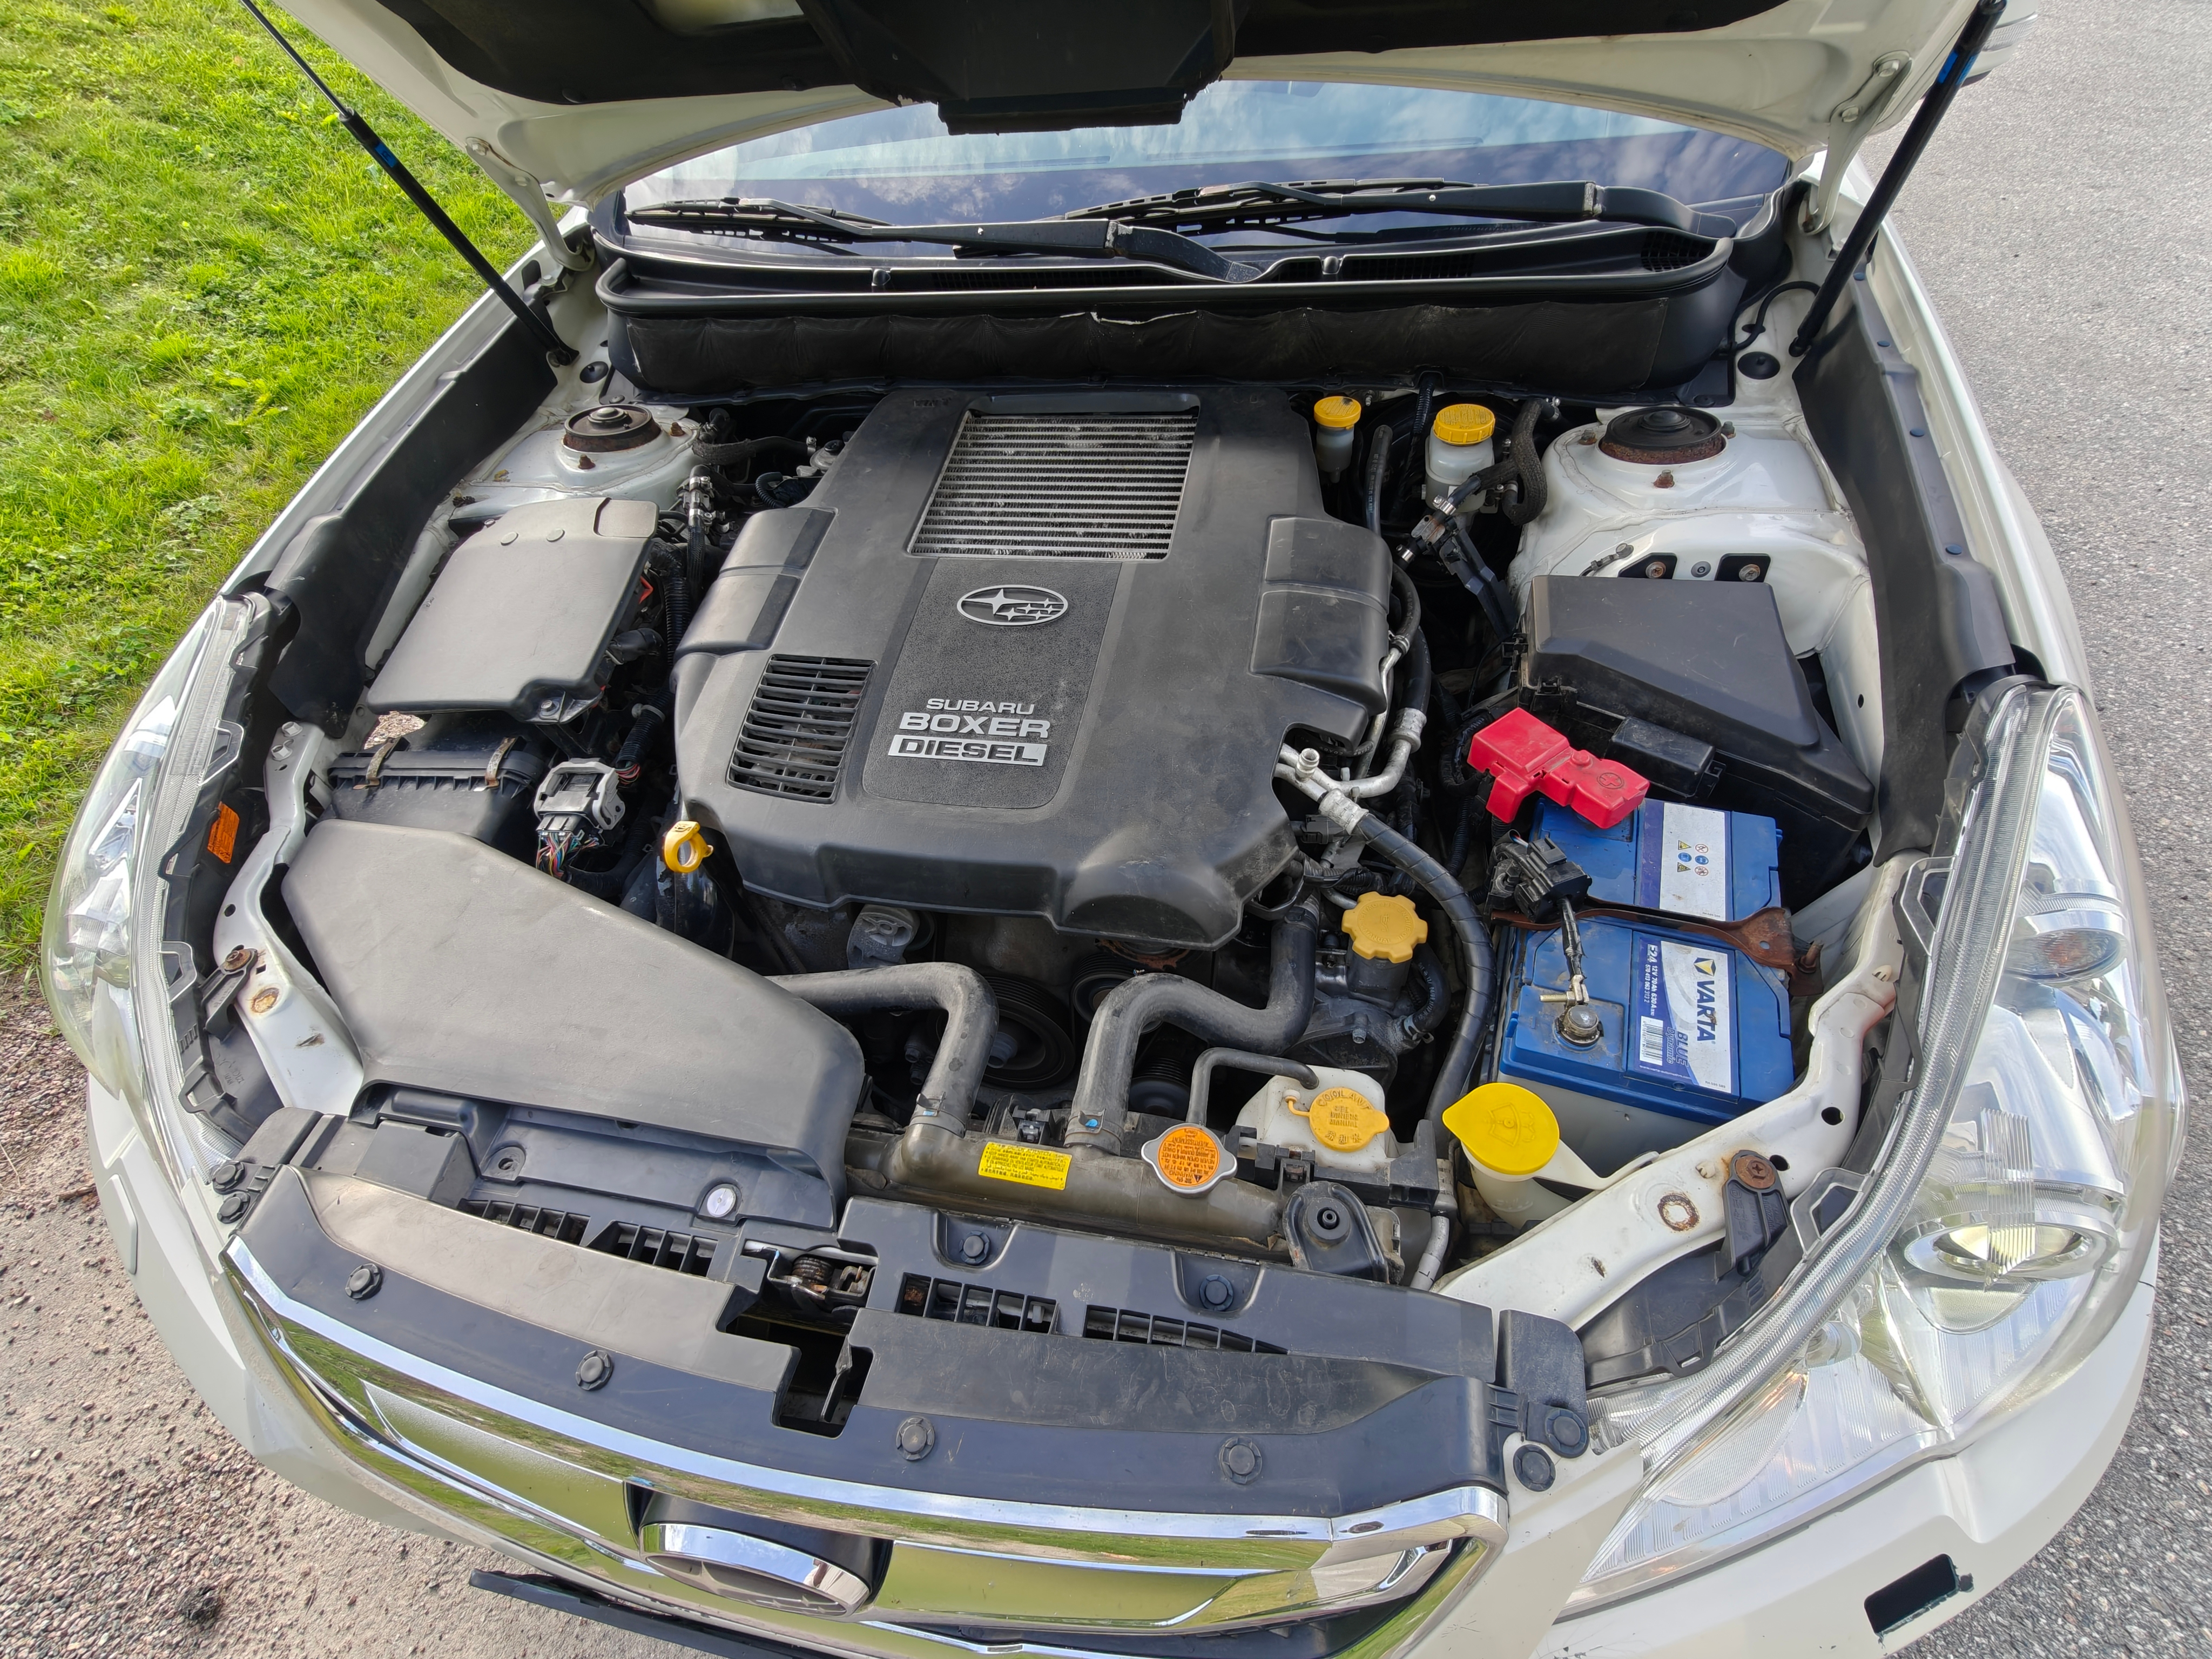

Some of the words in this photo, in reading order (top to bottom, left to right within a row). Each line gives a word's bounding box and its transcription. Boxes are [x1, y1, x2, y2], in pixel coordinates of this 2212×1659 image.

[926, 698, 1035, 714] SUBARU
[899, 712, 1050, 738] BOXER
[896, 737, 1040, 764] DIESEL
[1647, 943, 1658, 963] E24
[1697, 980, 1715, 1041] VARTA
[1665, 1026, 1676, 1064] Dynamic
[1676, 1031, 1689, 1067] BLUE
[1317, 1089, 1372, 1110] COOLANT
[1172, 1137, 1209, 1148] AVERTISSEMENT
[1169, 1170, 1193, 1178] WARNING
